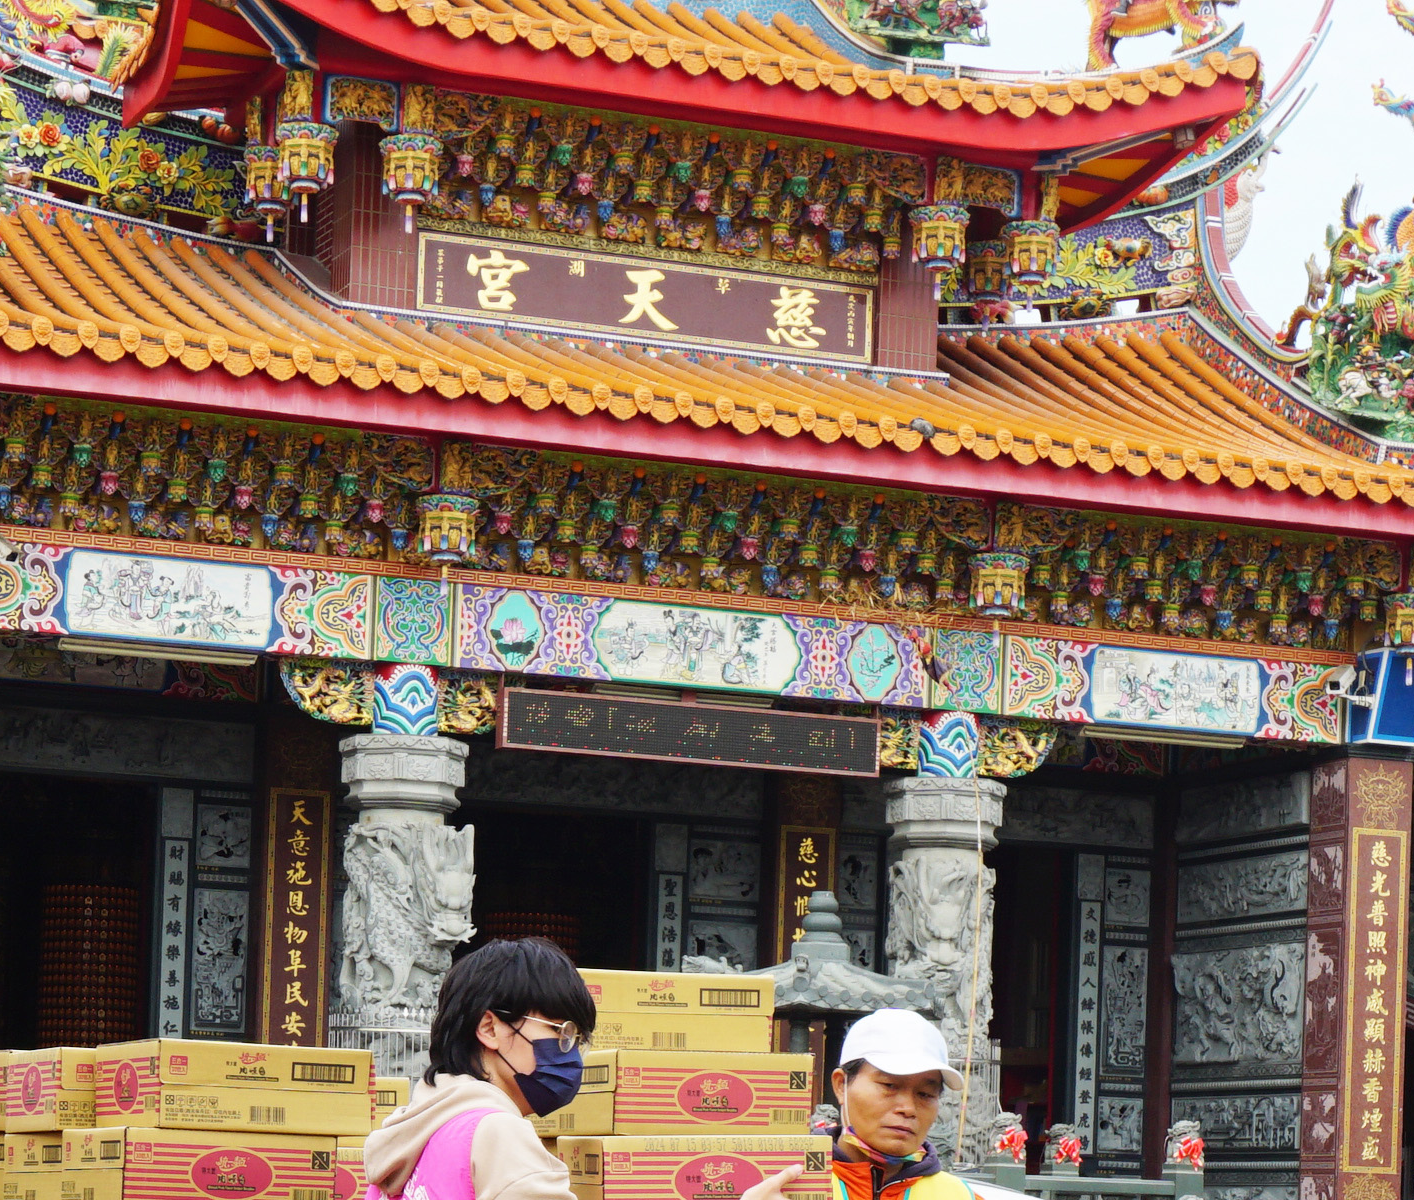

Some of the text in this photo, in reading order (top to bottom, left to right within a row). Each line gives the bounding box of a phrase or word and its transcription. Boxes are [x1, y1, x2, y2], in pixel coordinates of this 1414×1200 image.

[281, 800, 314, 1046] 天意施恩物阜民安
